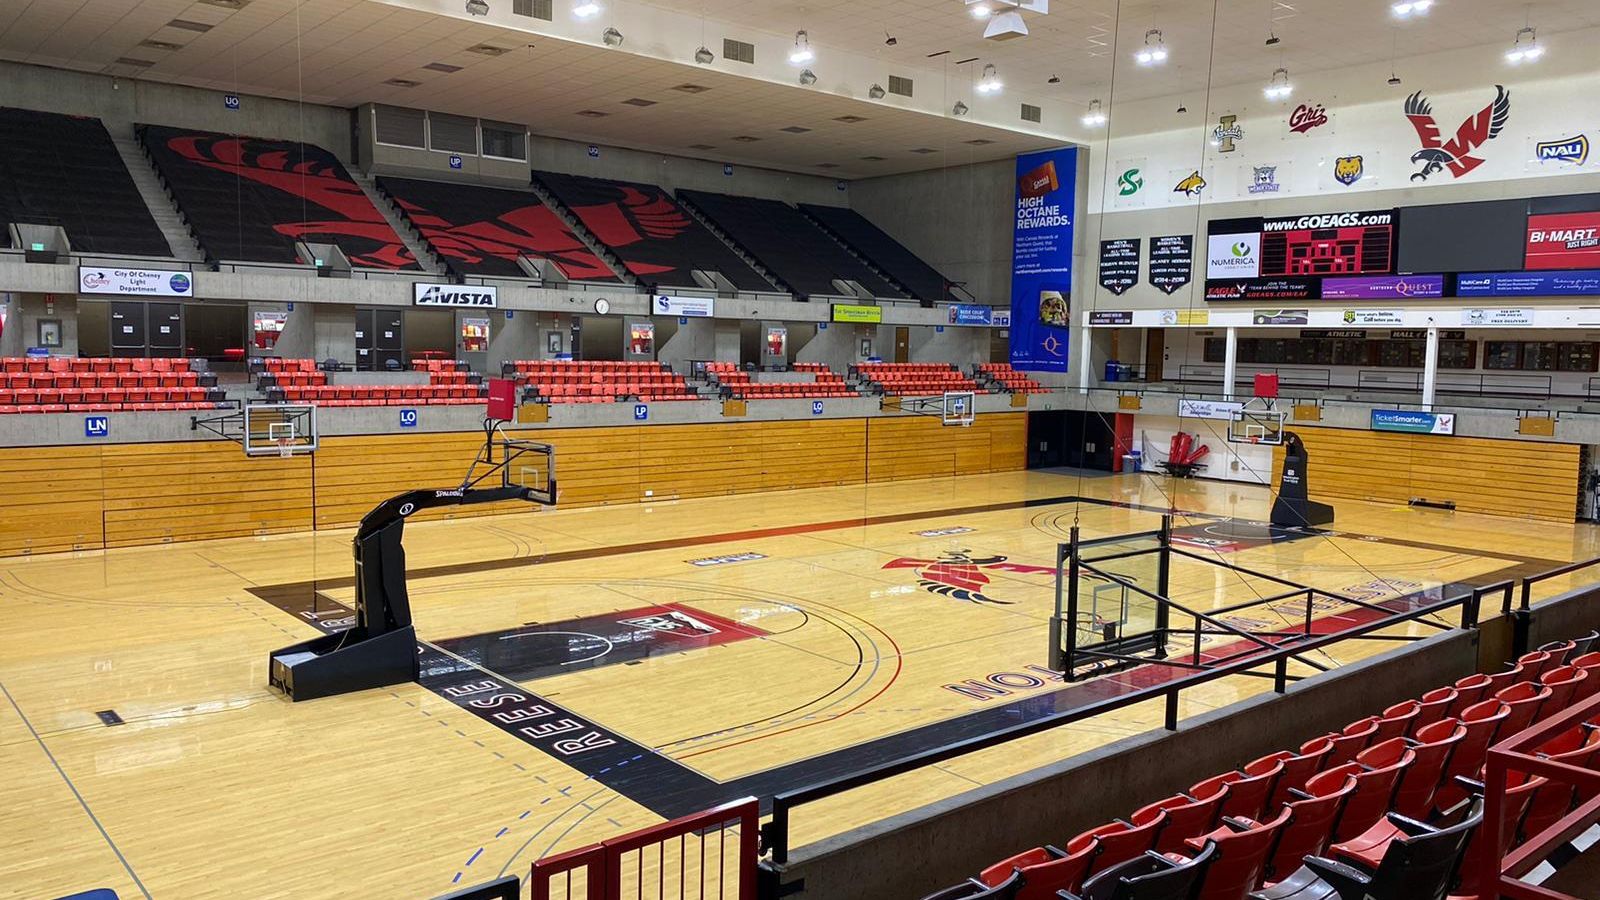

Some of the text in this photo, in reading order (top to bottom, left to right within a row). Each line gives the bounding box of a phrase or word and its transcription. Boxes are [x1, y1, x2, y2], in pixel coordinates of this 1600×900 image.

[1290, 104, 1328, 129] Griz
[1541, 144, 1582, 157] NAU
[450, 157, 461, 165] UP
[1018, 196, 1044, 208] HIGH
[1018, 205, 1060, 219] OCTANE
[1017, 215, 1071, 229] REWARDS.
[1263, 213, 1391, 231] www.GOEAGS.com
[1567, 238, 1599, 249] JUST RIGHT
[1211, 257, 1255, 267] NUMERICA
[138, 271, 161, 280] Cheney
[130, 279, 146, 287] Light
[119, 285, 157, 293] Department
[1207, 287, 1237, 295] EAGLE
[401, 411, 415, 422] LO
[636, 406, 646, 416] LP
[1375, 414, 1432, 424] TicketSmarter.com
[88, 419, 107, 431] LN
[444, 680, 617, 755] REESE
